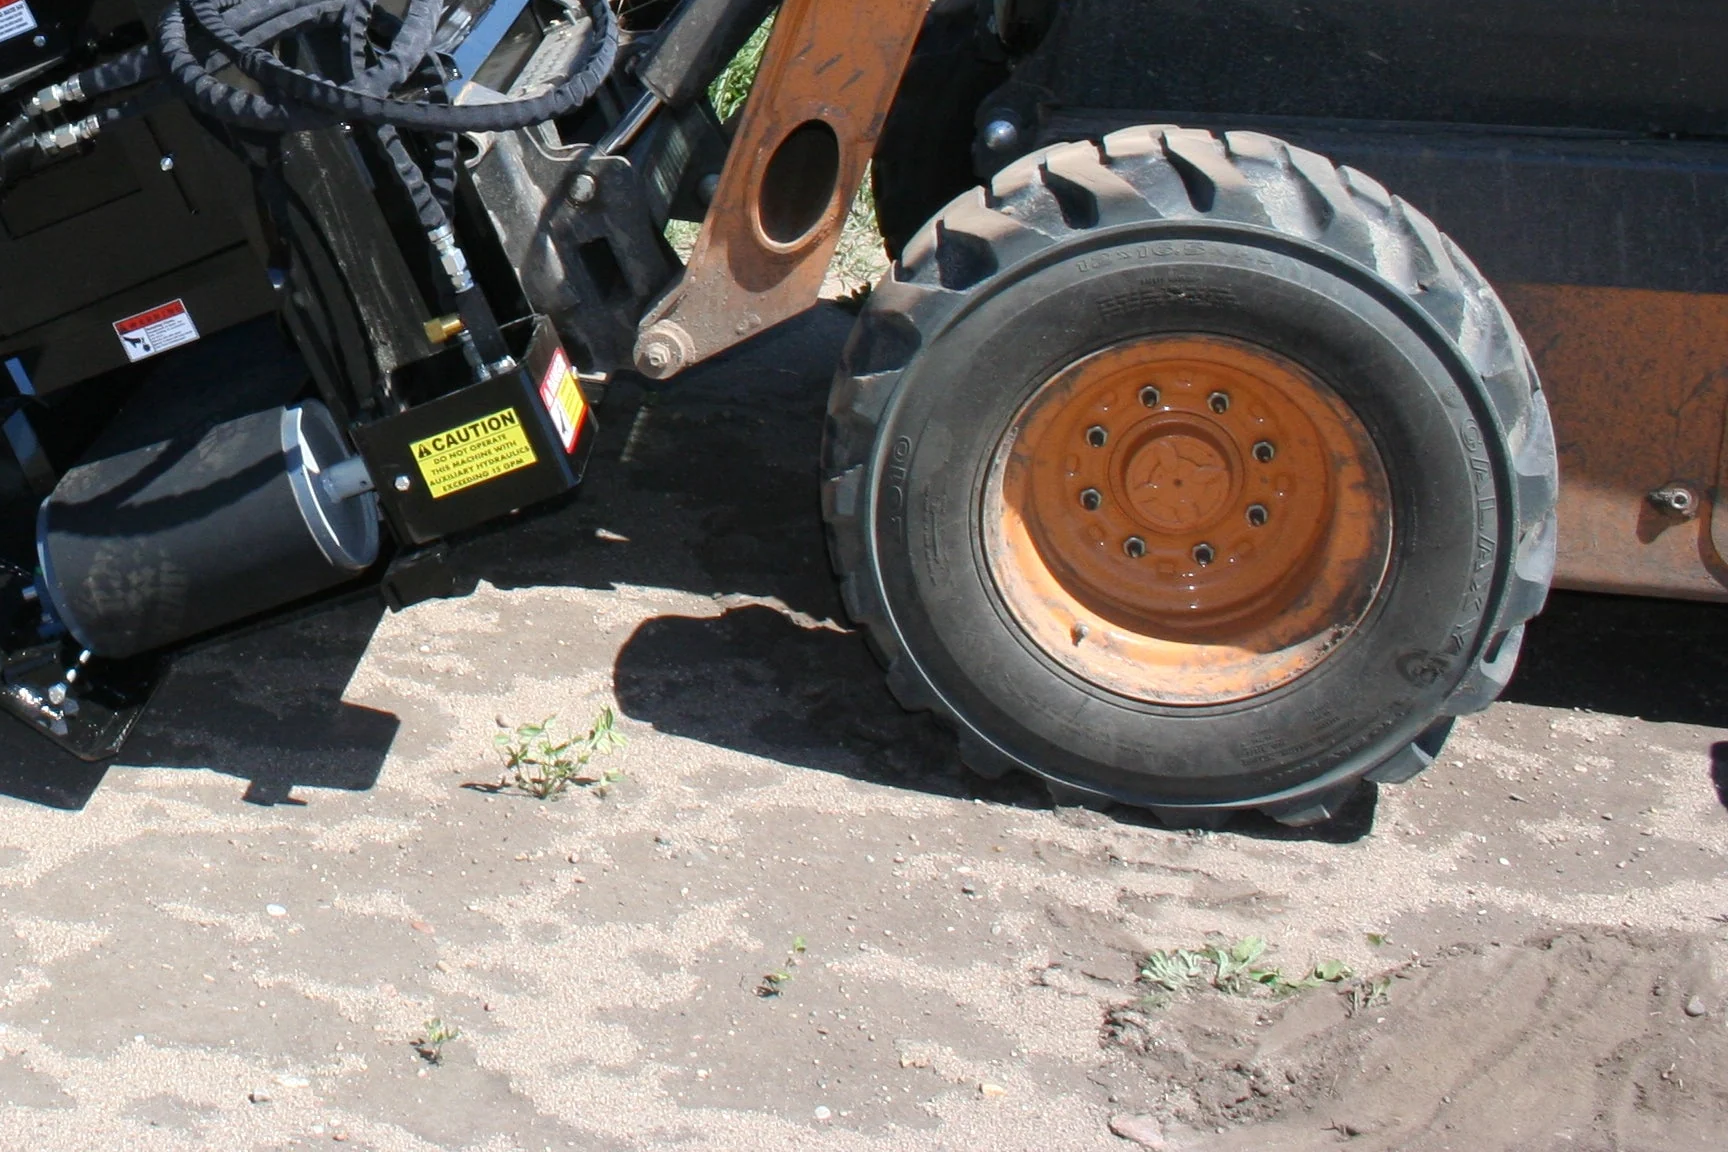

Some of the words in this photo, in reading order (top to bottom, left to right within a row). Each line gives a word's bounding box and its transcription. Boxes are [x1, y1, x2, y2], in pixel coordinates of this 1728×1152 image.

[432, 410, 516, 452] CAUTION
[433, 455, 448, 465] DO
[449, 449, 469, 461] NOT
[471, 433, 507, 452] OPERATE
[430, 465, 475, 487] AUXILIARY
[476, 445, 530, 470] HYDRAULICS
[432, 464, 451, 476] THIS
[453, 450, 492, 468] MACHINE
[494, 440, 517, 452] WITH
[442, 470, 490, 492] EXCEEDING
[503, 458, 525, 470] GPM
